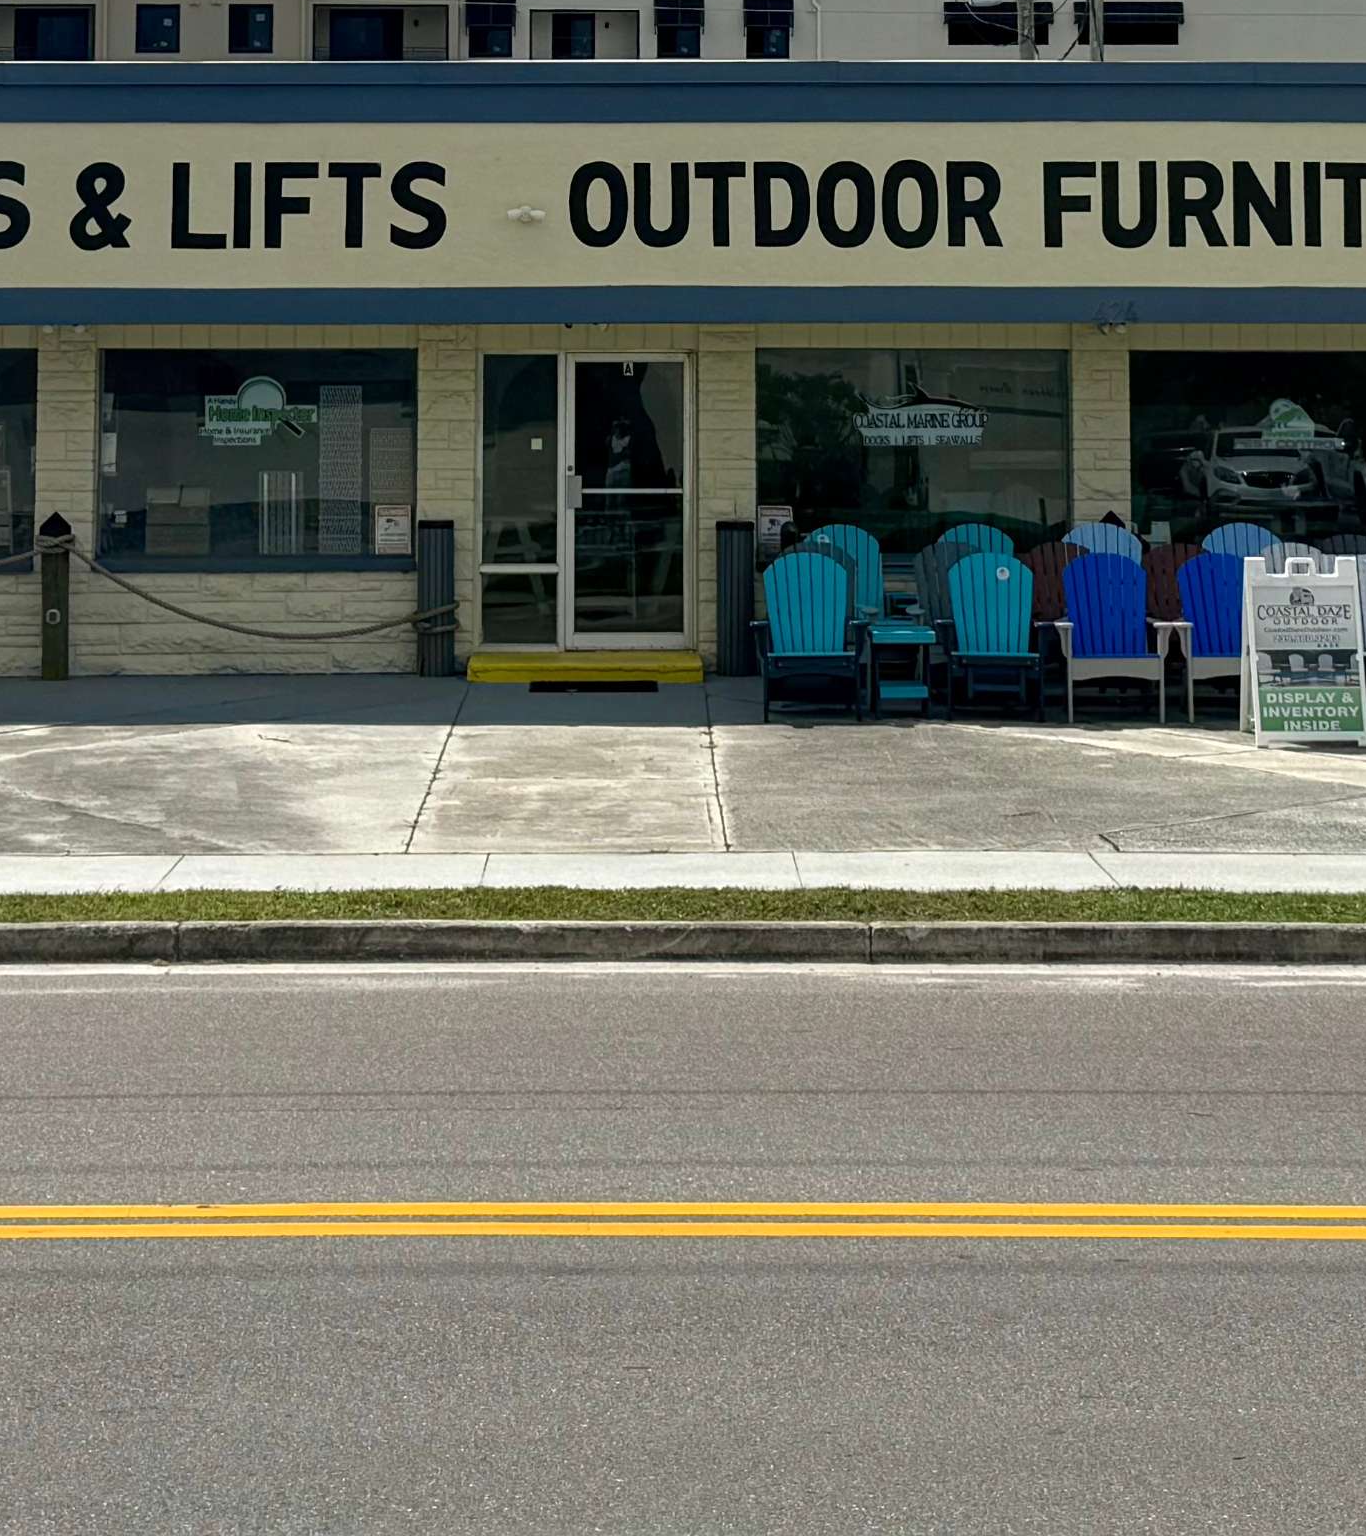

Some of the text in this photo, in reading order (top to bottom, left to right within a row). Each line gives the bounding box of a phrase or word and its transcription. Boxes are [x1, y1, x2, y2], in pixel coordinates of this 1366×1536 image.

[69, 160, 133, 252] &
[171, 160, 447, 251] LIFTS
[568, 159, 1004, 249] OUTDOOR
[209, 406, 251, 422] Home
[852, 413, 989, 429] COASTAL MARINE GROUP
[863, 435, 981, 445] DOCKS LIFTS SEAWALLS
[1257, 604, 1352, 621] COASTAL DAZE
[1273, 617, 1338, 626] OUTDOOR
[1266, 692, 1355, 704] DISPLAY &
[1262, 706, 1359, 718] INVENTORY
[1283, 720, 1341, 731] INSIDE
